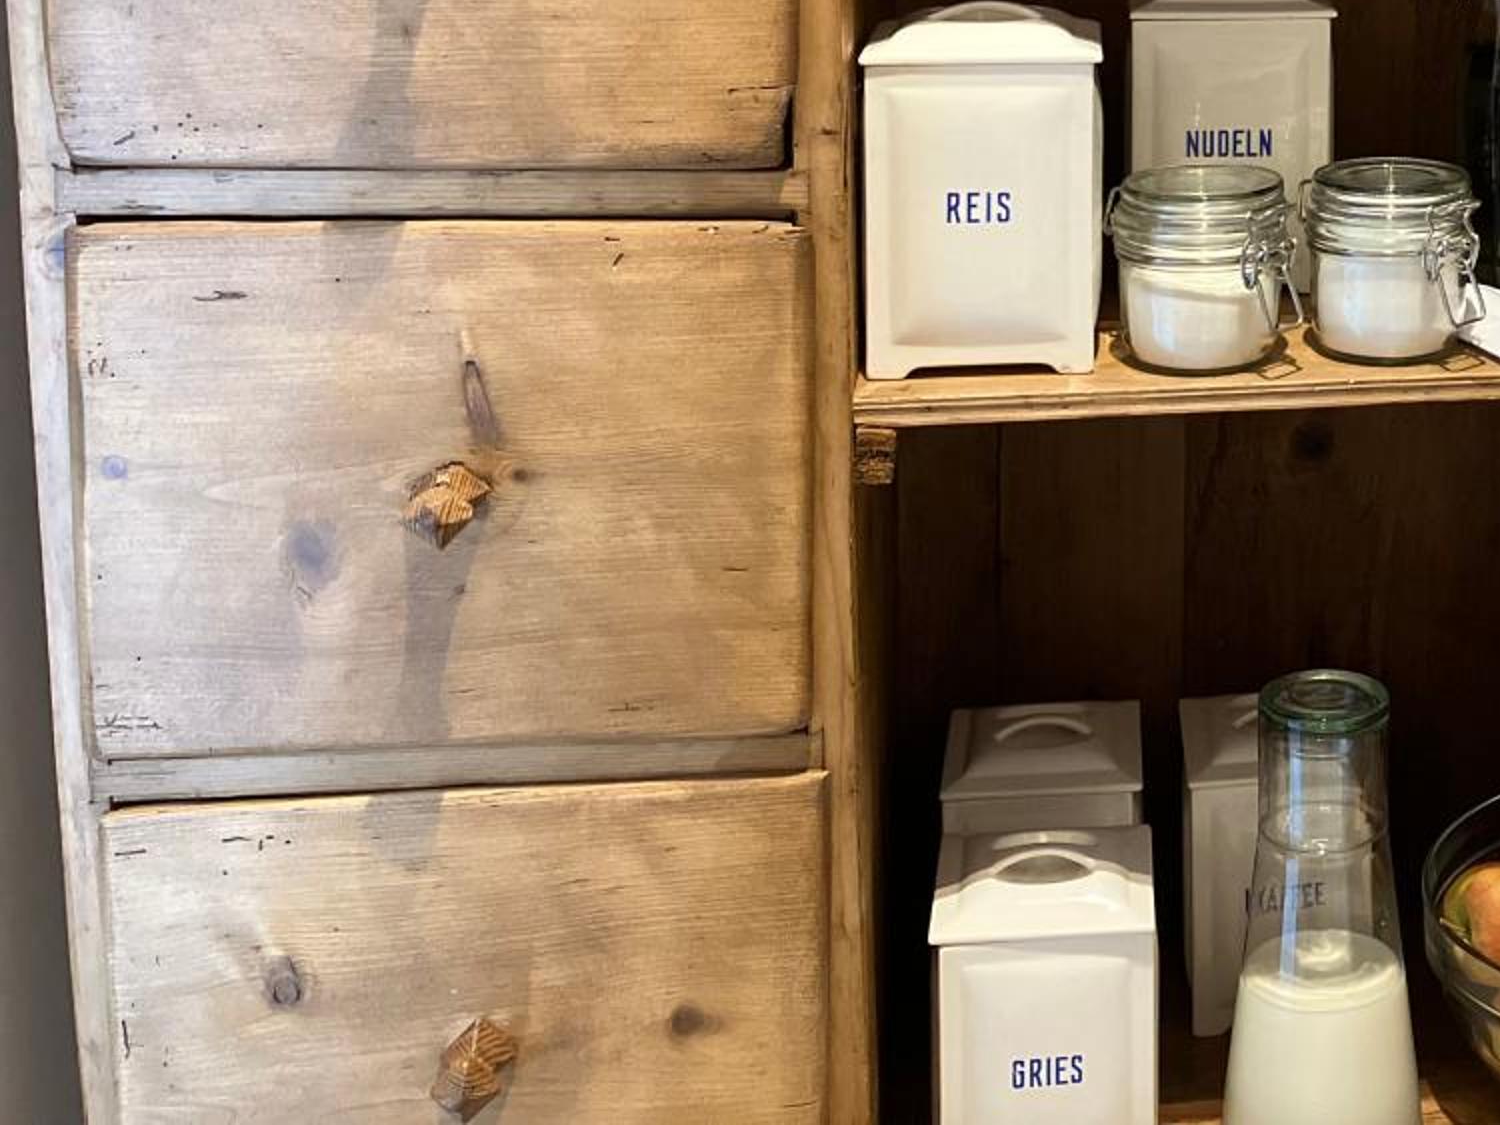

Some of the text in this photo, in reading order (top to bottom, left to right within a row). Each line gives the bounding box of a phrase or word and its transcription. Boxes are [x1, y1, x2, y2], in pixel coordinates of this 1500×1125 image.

[1185, 128, 1273, 158] NUDELN
[946, 192, 1012, 224] REIS
[1011, 1054, 1085, 1089] GRIES
